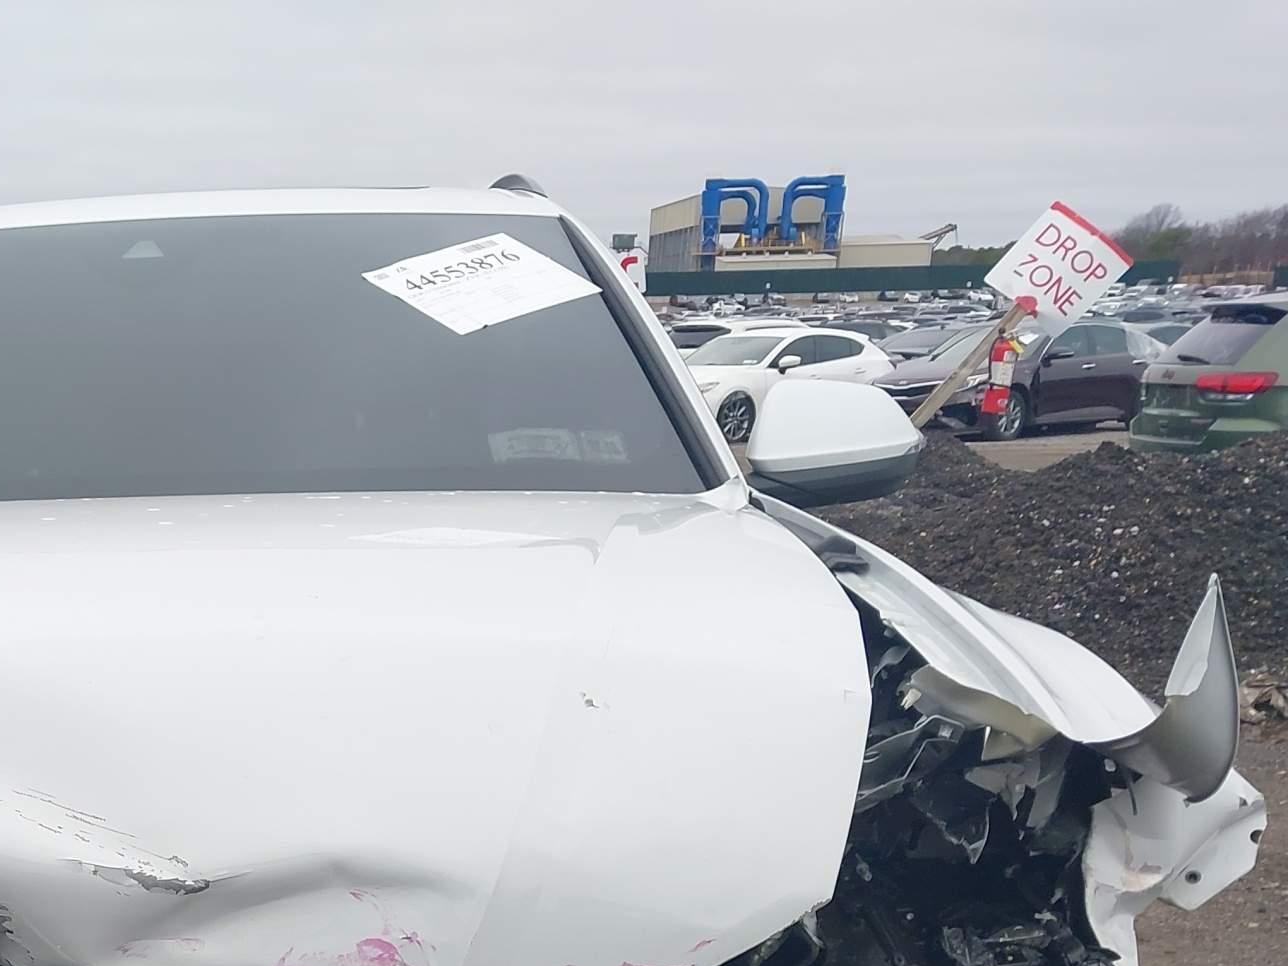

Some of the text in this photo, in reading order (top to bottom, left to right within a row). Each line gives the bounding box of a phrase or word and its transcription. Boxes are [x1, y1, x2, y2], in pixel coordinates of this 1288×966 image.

[405, 249, 521, 291] 44553876
[1034, 223, 1108, 283] DROP
[1013, 253, 1083, 317] ZONE
